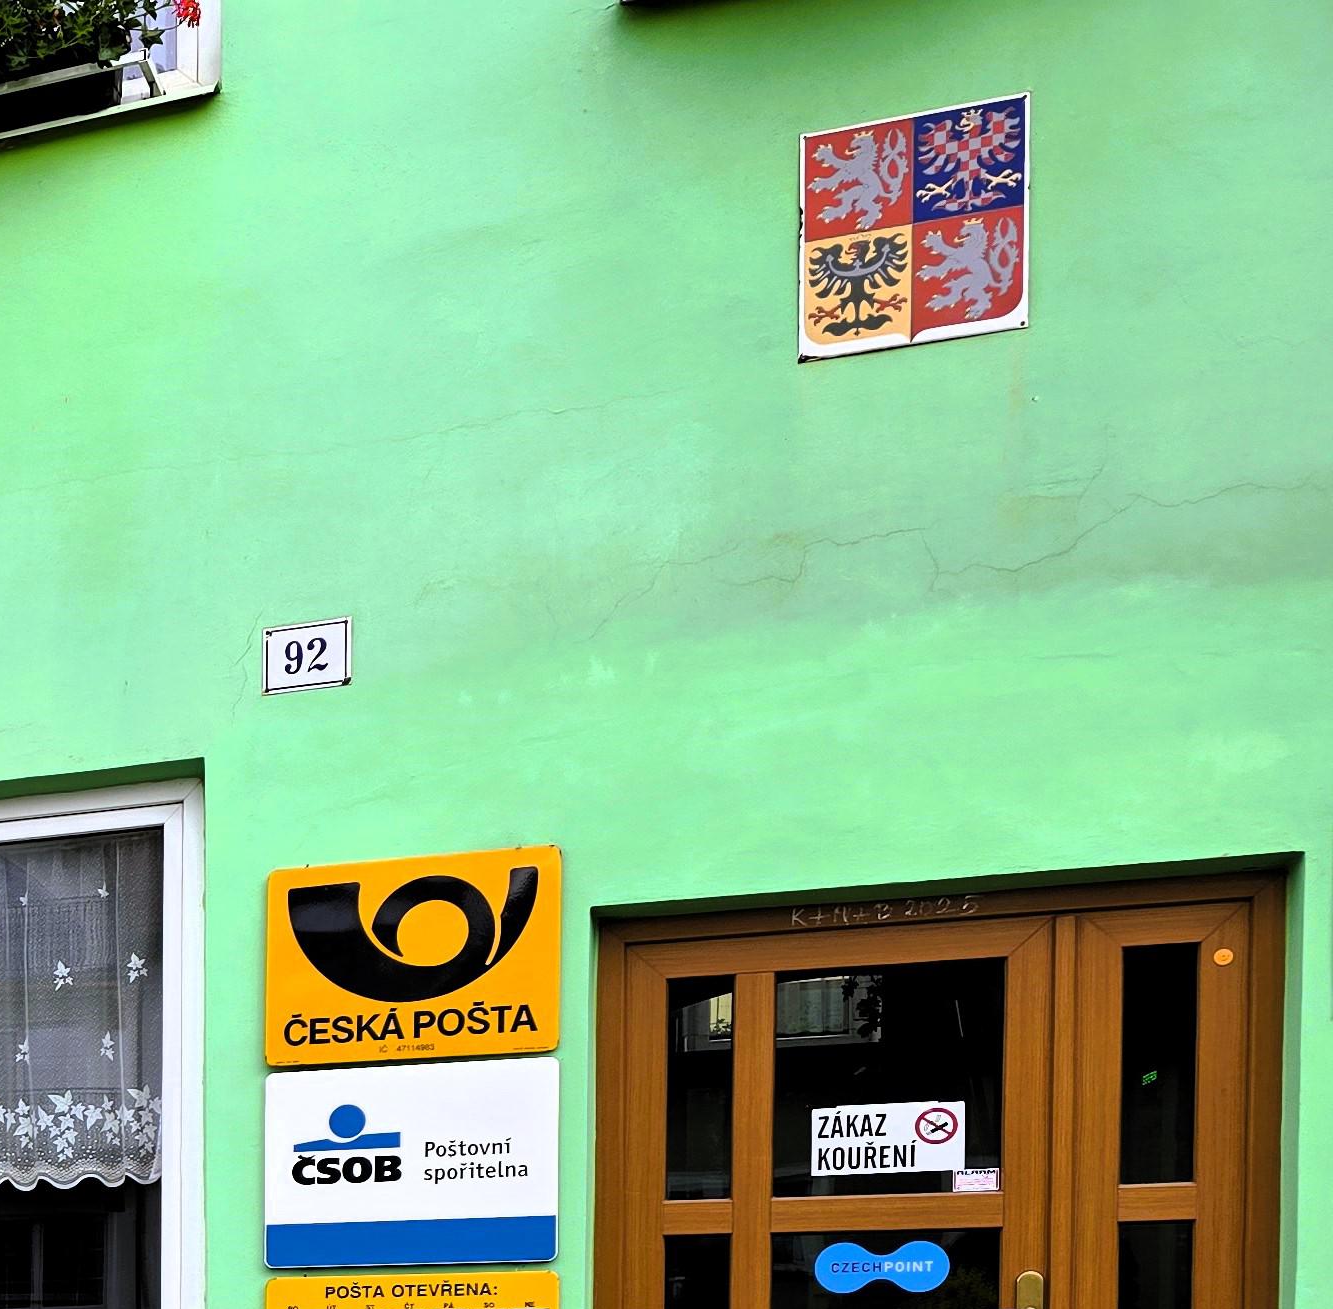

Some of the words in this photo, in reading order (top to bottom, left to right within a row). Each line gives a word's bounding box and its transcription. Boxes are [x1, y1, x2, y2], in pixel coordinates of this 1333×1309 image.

[285, 637, 328, 674] 92
[904, 895, 981, 916] 2025
[283, 1007, 405, 1046] ČESKÁ
[413, 1002, 538, 1039] POŠTA
[817, 1111, 887, 1138] ZÁKAZ
[424, 1137, 512, 1158] Poštovní
[817, 1140, 917, 1170] KOUŘENÍ
[292, 1154, 402, 1186] ČSOB
[423, 1161, 529, 1185] spořitelna
[325, 1282, 384, 1299] POŠTA
[391, 1280, 498, 1298] OTEVŘENA:
